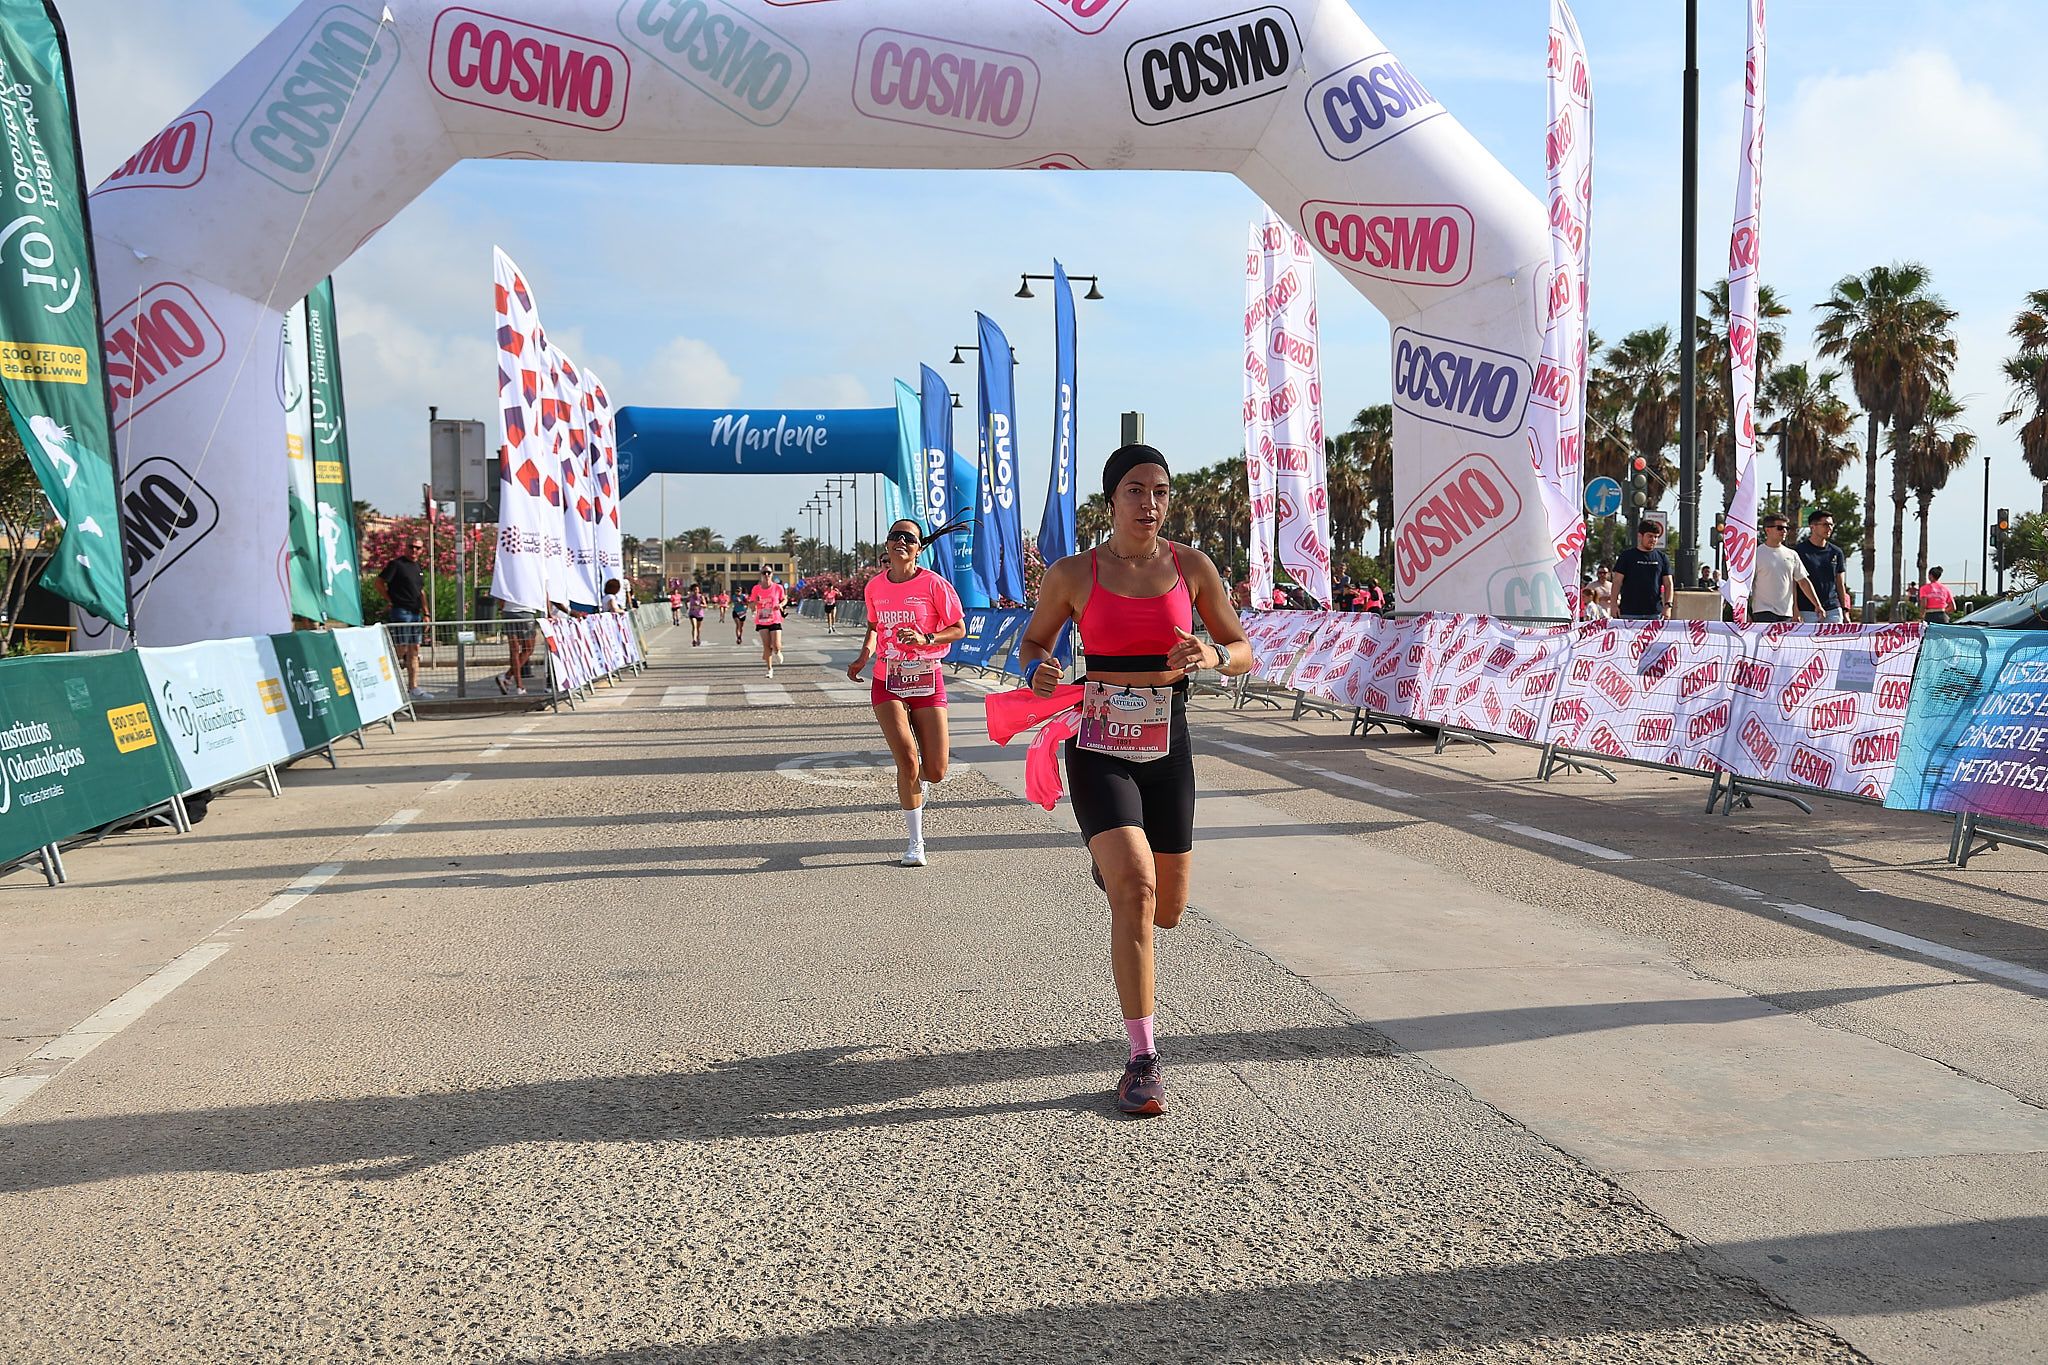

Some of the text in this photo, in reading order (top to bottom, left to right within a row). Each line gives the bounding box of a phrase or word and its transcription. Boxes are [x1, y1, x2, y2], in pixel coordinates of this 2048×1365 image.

[447, 21, 613, 118] COSMO
[636, 0, 792, 111] COSMO
[1141, 17, 1290, 110] COSMO
[250, 20, 383, 174] COSMO
[870, 41, 1024, 127] COSMO
[1315, 211, 1460, 274] COSMO
[1396, 340, 1518, 422] COSMO
[1396, 469, 1504, 586] COSMO
[901, 675, 920, 683] 016
[1525, 671, 1557, 696] COSMO
[1596, 666, 1632, 706] COSMO
[1642, 645, 1678, 692] COSMO
[1681, 661, 1718, 698] COSMO
[1731, 659, 1770, 692] COSMO
[1782, 655, 1824, 712] COSMO
[1111, 697, 1145, 708] ASTURIANA
[1812, 697, 1855, 732] COSMO
[1973, 693, 2034, 716] JUNTOS
[1108, 722, 1142, 738] 016
[1508, 708, 1536, 740] COSMO
[1637, 719, 1672, 742] COSMO
[1689, 704, 1728, 741] COSMO
[1958, 719, 2046, 752] CÁNCER DE
[1741, 718, 1777, 771] COSMO
[1852, 731, 1900, 766] COSMO
[7, 744, 86, 784] Odontológicos
[1791, 748, 1833, 790] COSMO
[1952, 756, 2048, 793] METASTÁSI
